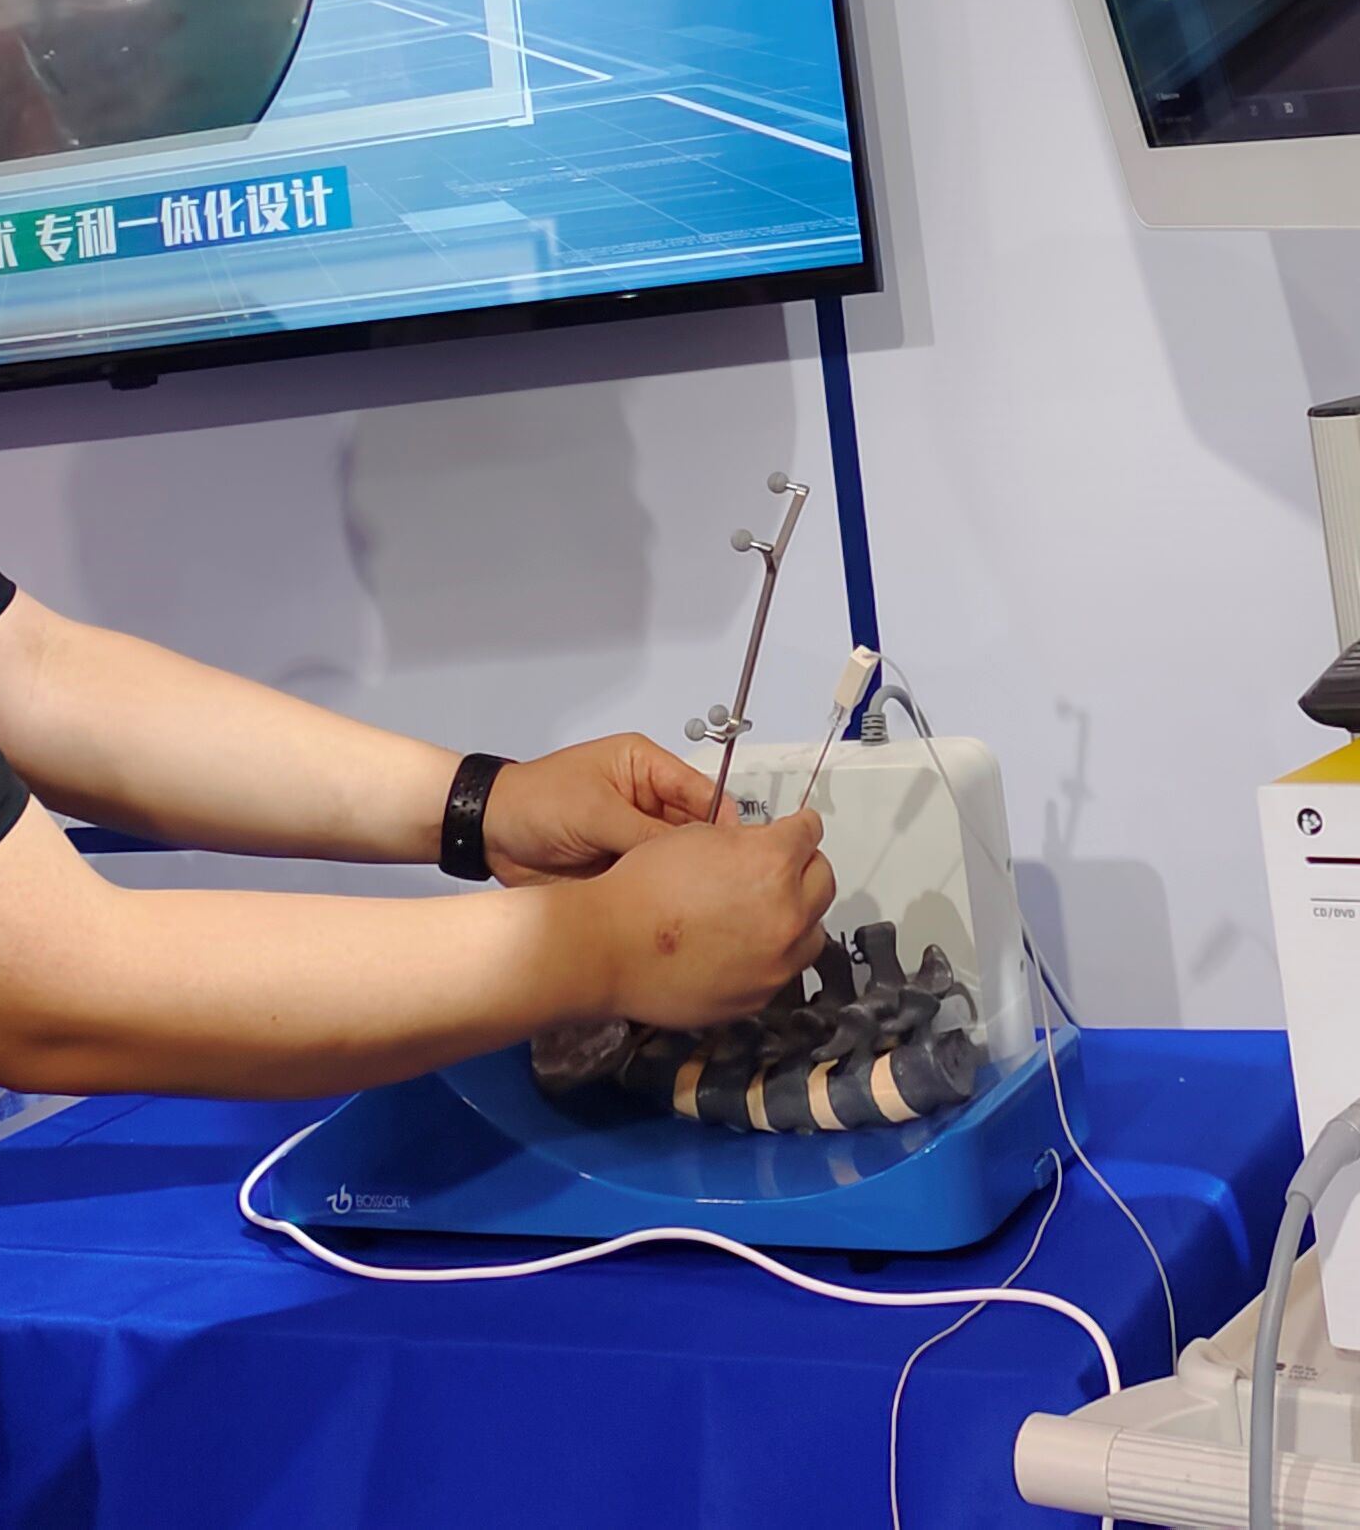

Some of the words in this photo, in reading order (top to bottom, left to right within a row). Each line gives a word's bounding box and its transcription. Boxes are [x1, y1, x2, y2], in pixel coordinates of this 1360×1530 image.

[35, 175, 334, 262] 专利一体化设计
[1313, 907, 1356, 918] CD/DVD
[356, 1194, 411, 1209] BOSSCOME
